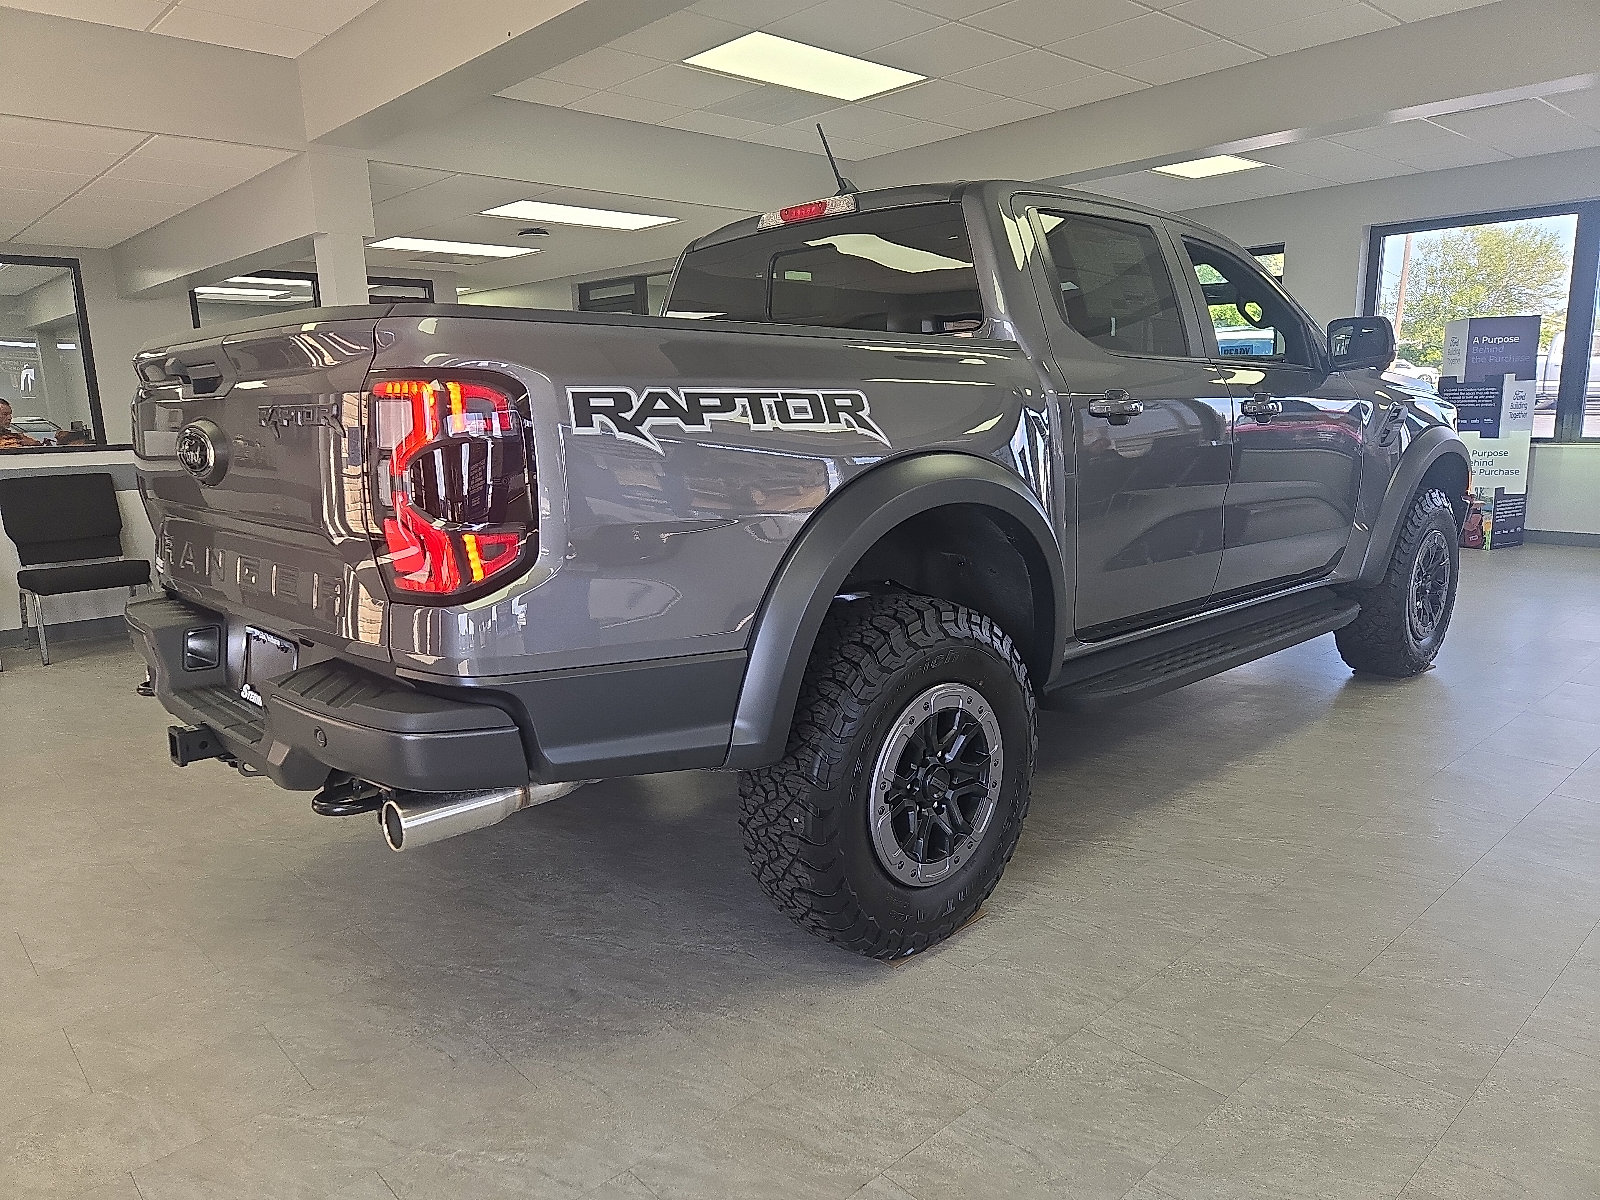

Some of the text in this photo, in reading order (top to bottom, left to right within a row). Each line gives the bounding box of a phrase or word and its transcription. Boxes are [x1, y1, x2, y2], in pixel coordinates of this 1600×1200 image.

[1472, 336, 1520, 344] A Purpose
[1472, 346, 1505, 354] Behind
[1489, 354, 1531, 363] Purchase
[1510, 402, 1528, 410] Building
[257, 403, 347, 438] RAPTOR
[1509, 411, 1528, 421] Together
[565, 386, 893, 457] RAPTOR
[1471, 449, 1509, 458] Purpose
[1478, 468, 1520, 476] Purchase
